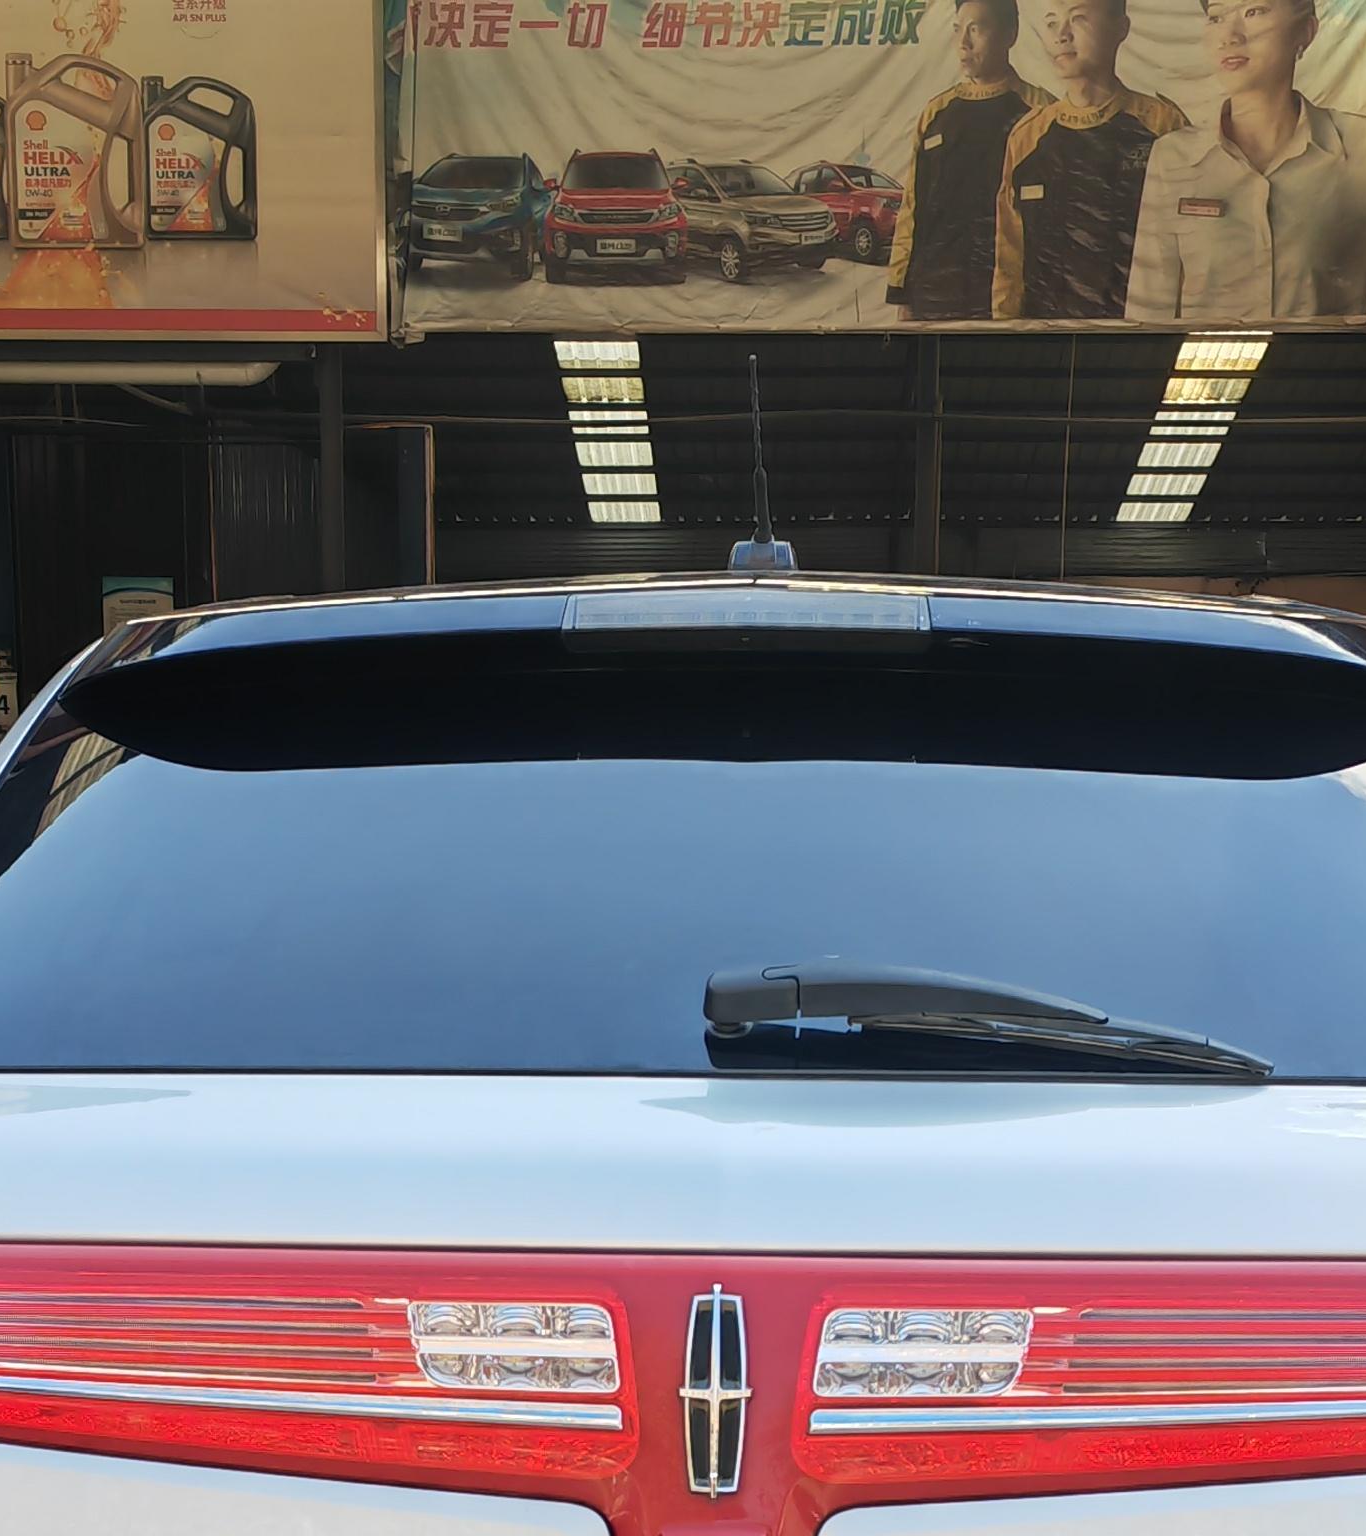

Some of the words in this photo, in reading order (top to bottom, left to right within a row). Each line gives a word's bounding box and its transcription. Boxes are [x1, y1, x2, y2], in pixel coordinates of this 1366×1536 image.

[642, 2, 927, 48] 细节决定成败
[23, 140, 48, 150] Shell
[23, 146, 83, 165] HELIX
[24, 167, 70, 177] ULTRA
[156, 170, 195, 179] ULTRA
